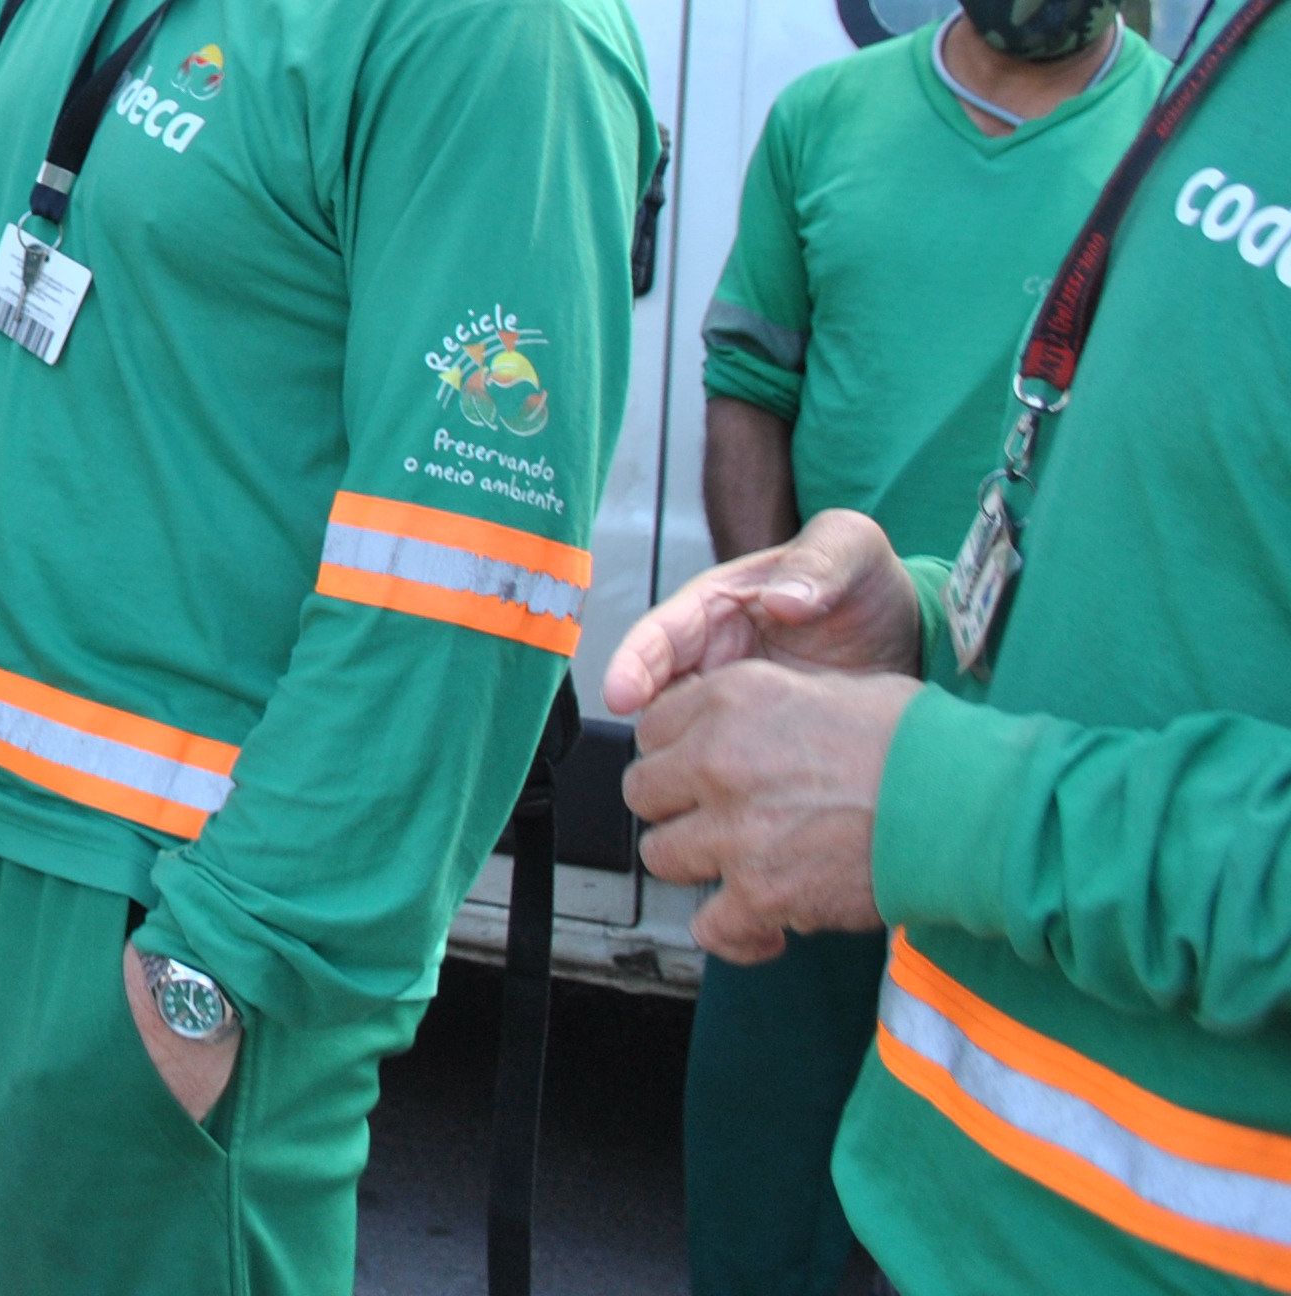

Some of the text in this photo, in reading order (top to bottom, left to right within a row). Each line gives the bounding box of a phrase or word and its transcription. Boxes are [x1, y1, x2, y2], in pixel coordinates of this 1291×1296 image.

[111, 65, 206, 154] deca
[424, 302, 519, 372] Recicle
[433, 427, 555, 481] Preservando
[424, 460, 475, 486] meio
[480, 474, 565, 515] ambiente
